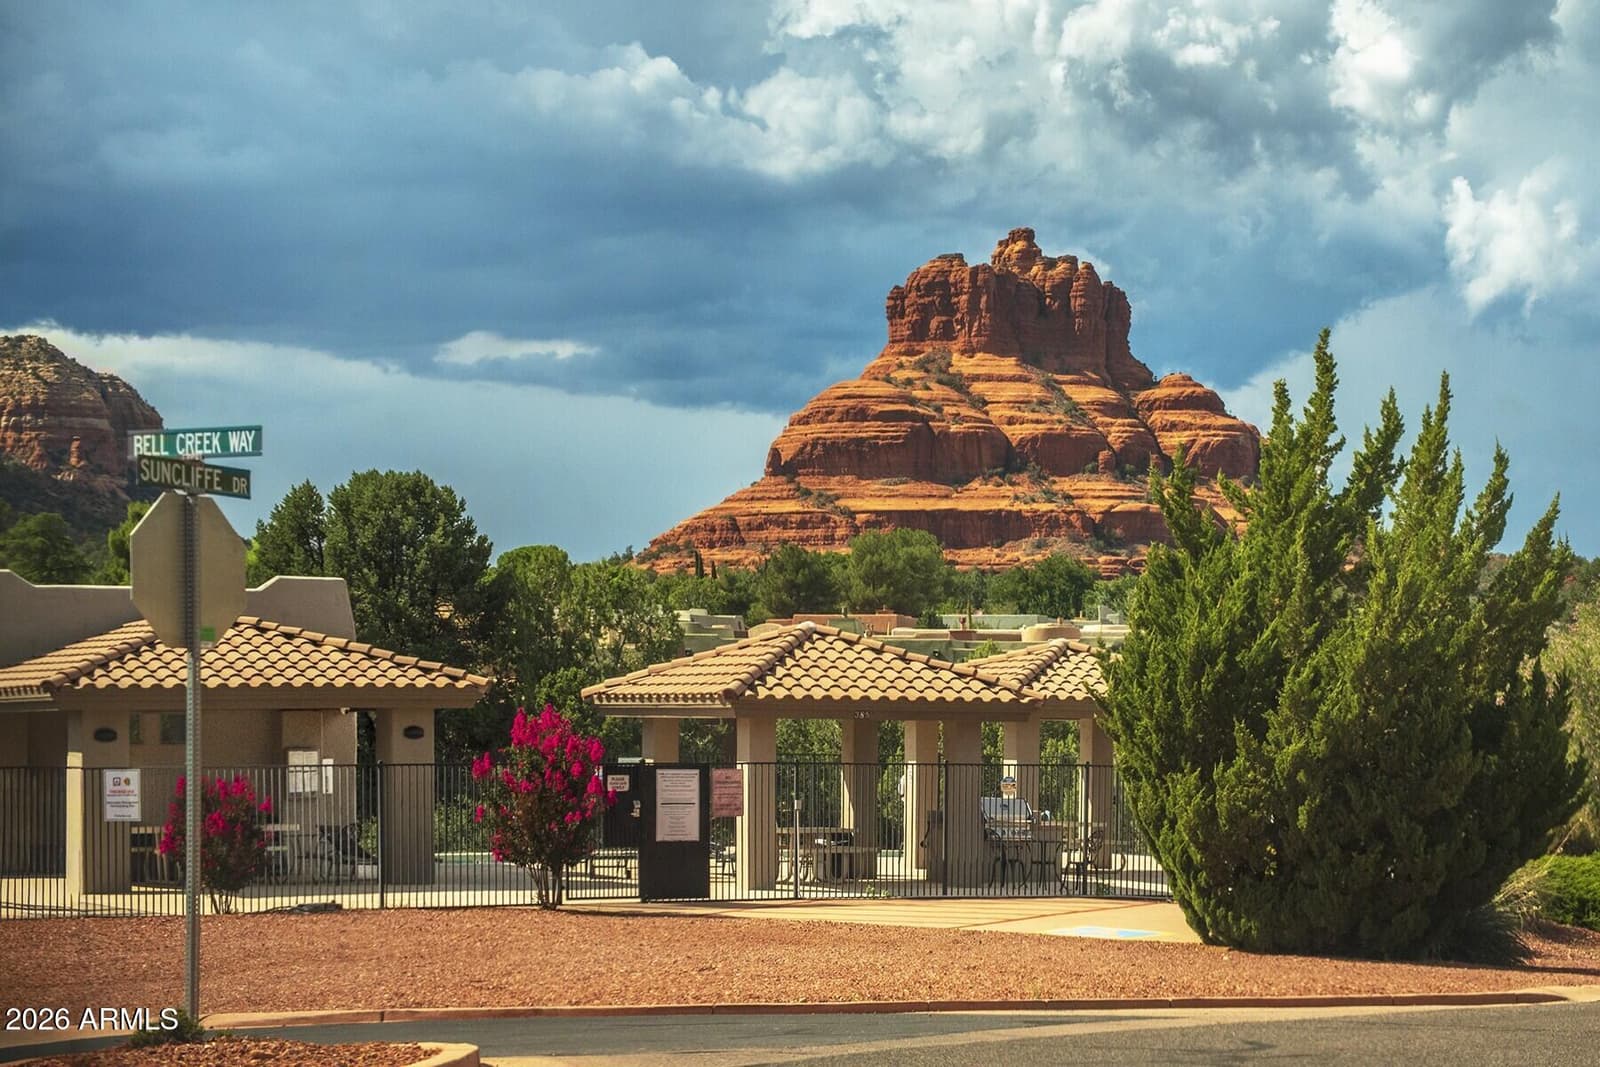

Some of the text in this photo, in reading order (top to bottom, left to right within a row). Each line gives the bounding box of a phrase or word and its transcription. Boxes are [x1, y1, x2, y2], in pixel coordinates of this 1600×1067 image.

[133, 430, 255, 456] BELL CREEK WAY
[140, 459, 248, 495] SUNCLIFFE DR
